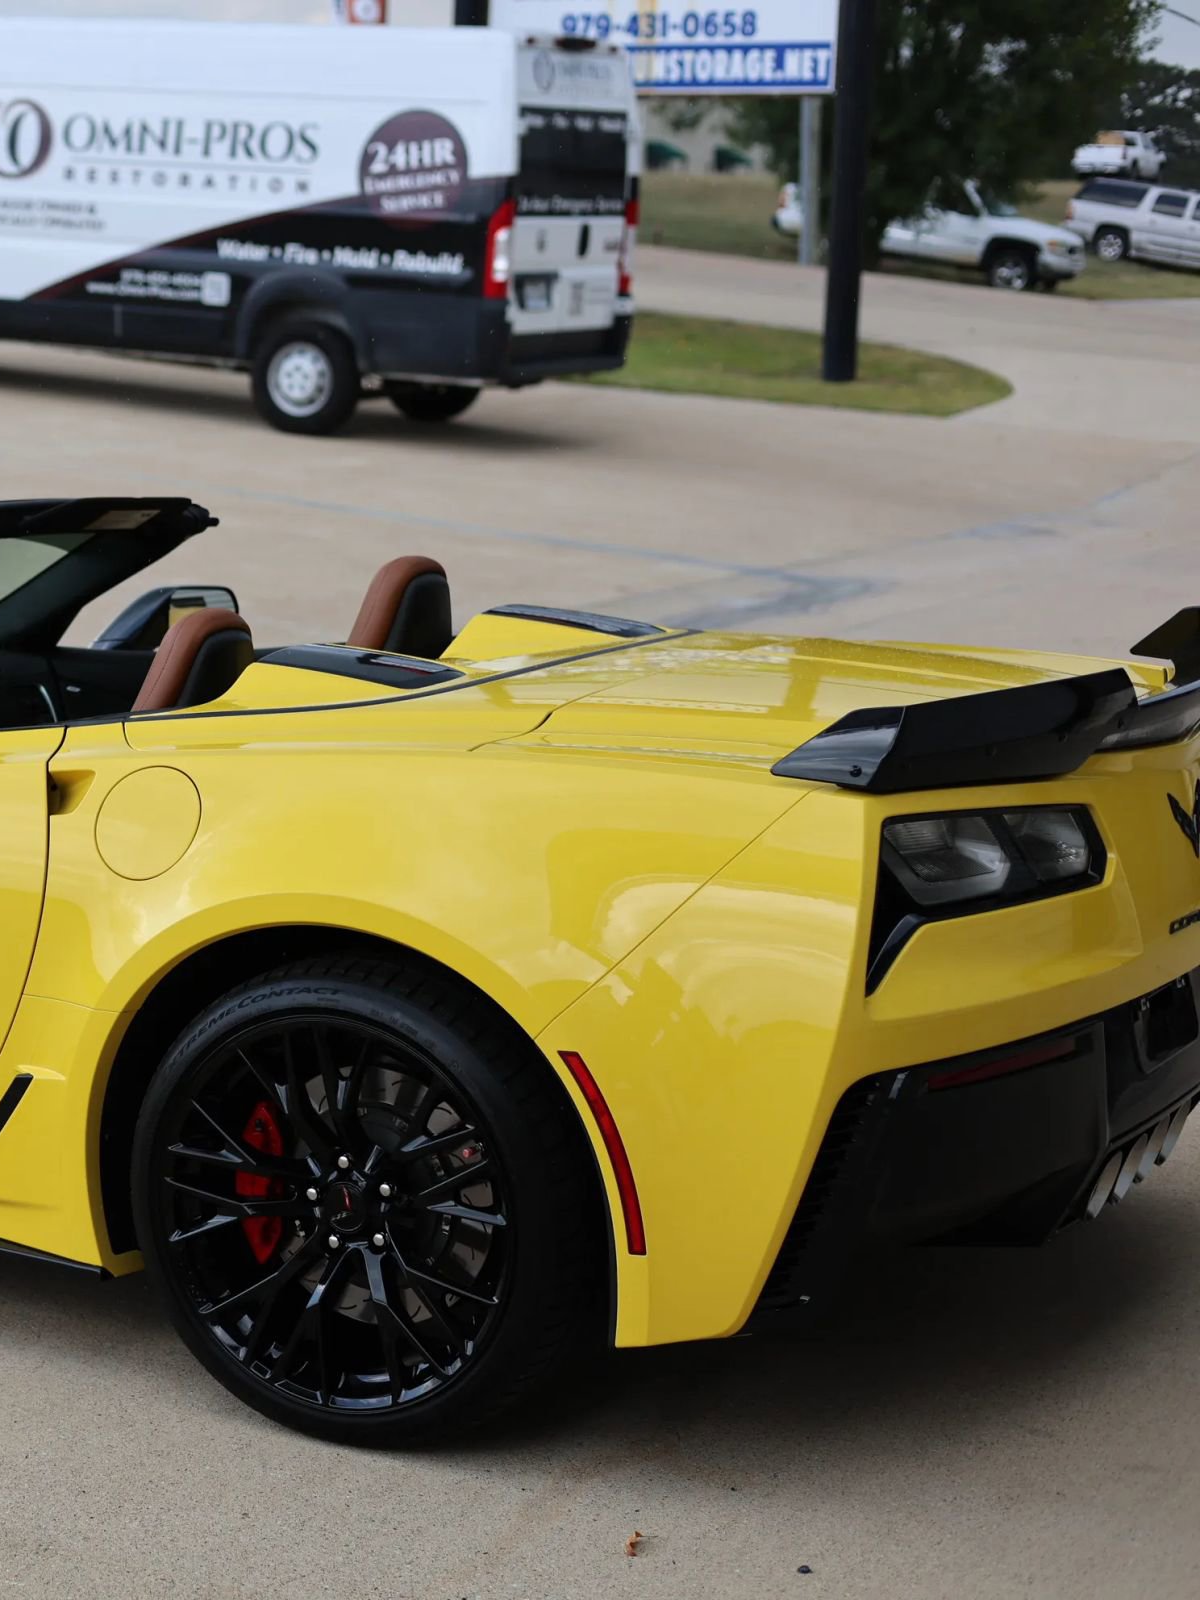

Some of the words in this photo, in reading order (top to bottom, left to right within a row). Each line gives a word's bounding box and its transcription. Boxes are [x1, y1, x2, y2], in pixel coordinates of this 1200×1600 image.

[561, 10, 758, 39] 979-431-0658
[63, 113, 321, 164] OMNI-PROS
[367, 136, 456, 174] 24HR
[63, 167, 312, 194] RESTORATION
[217, 238, 270, 262] Water
[283, 242, 320, 266] Fire
[332, 245, 380, 269] Mold
[392, 248, 465, 274] Rebuild
